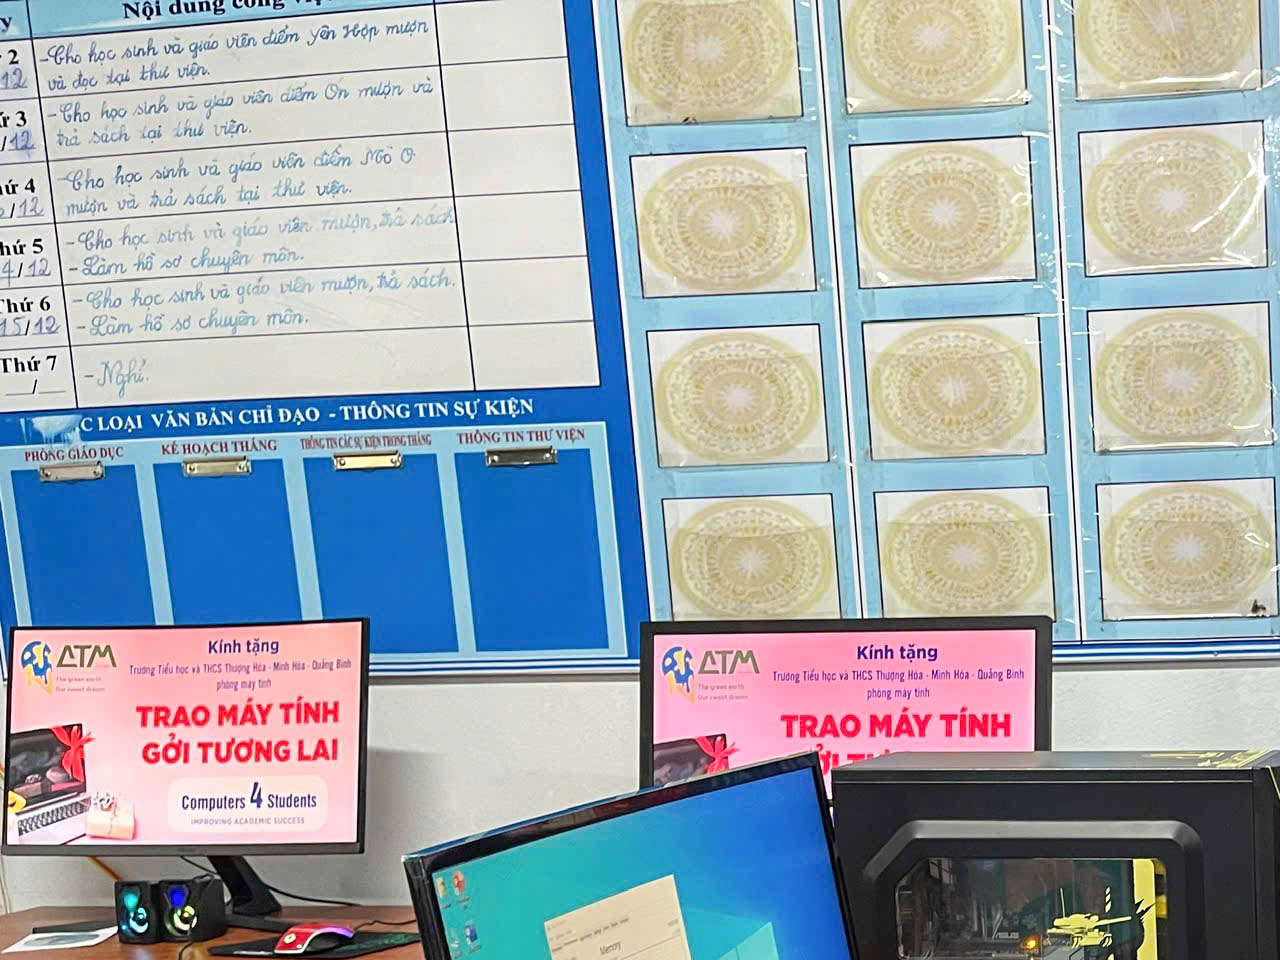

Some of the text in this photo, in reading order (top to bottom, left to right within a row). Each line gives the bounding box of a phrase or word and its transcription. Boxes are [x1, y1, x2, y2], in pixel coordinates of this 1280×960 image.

[123, 0, 226, 20] Nội dung
[88, 41, 116, 66] học
[122, 38, 158, 59] sinh
[163, 36, 184, 54] và
[188, 33, 219, 59] giáo
[226, 32, 258, 49] viên
[262, 24, 300, 46] điểm
[48, 74, 67, 90] và
[72, 69, 98, 92] đọc
[106, 67, 131, 86] tại
[100, 99, 128, 124] học
[132, 96, 169, 117] sinh
[177, 95, 198, 112] và
[242, 89, 273, 106] viên
[280, 81, 318, 104] điểm
[412, 75, 434, 95] và
[87, 122, 131, 146] sách
[114, 143, 352, 188] học sinh và giáo viên điểm
[117, 193, 140, 210] và
[182, 185, 227, 206] sách
[120, 224, 150, 248] học
[156, 222, 195, 244] sinh
[203, 222, 226, 239] và
[232, 215, 269, 247] giáo
[279, 216, 313, 234] viên
[31, 238, 45, 255] 5
[39, 295, 52, 312] 6
[131, 287, 164, 311] học
[167, 280, 206, 303] sinh
[209, 283, 231, 300] và
[236, 276, 270, 304] giáo
[279, 276, 314, 295] viên
[46, 355, 58, 371] 7
[98, 397, 535, 434] LOẠI VĂN BẢN CHỈ ĐẠO THÔNG TIN SỰ KIỆN
[182, 441, 231, 458] HOẠCH
[232, 436, 278, 453] THÁNG
[456, 428, 586, 446] THÔNG TIN THƯ VIỆN
[24, 446, 125, 463] PHÒNG GIÁO DỤC
[56, 644, 117, 668] ATM
[208, 639, 280, 656] Kính tặng
[856, 645, 939, 663] Kính tặng
[698, 649, 761, 675] ATM
[821, 670, 838, 682] học
[851, 670, 873, 681] THCS
[931, 669, 951, 680] Minh
[136, 696, 341, 728] TRAO MÁY TÍNH
[781, 707, 1012, 739] TRAO MÁY TÍNH
[142, 732, 339, 765] GỞI TƯƠNG LAI
[181, 781, 318, 812] Computers 4 Students
